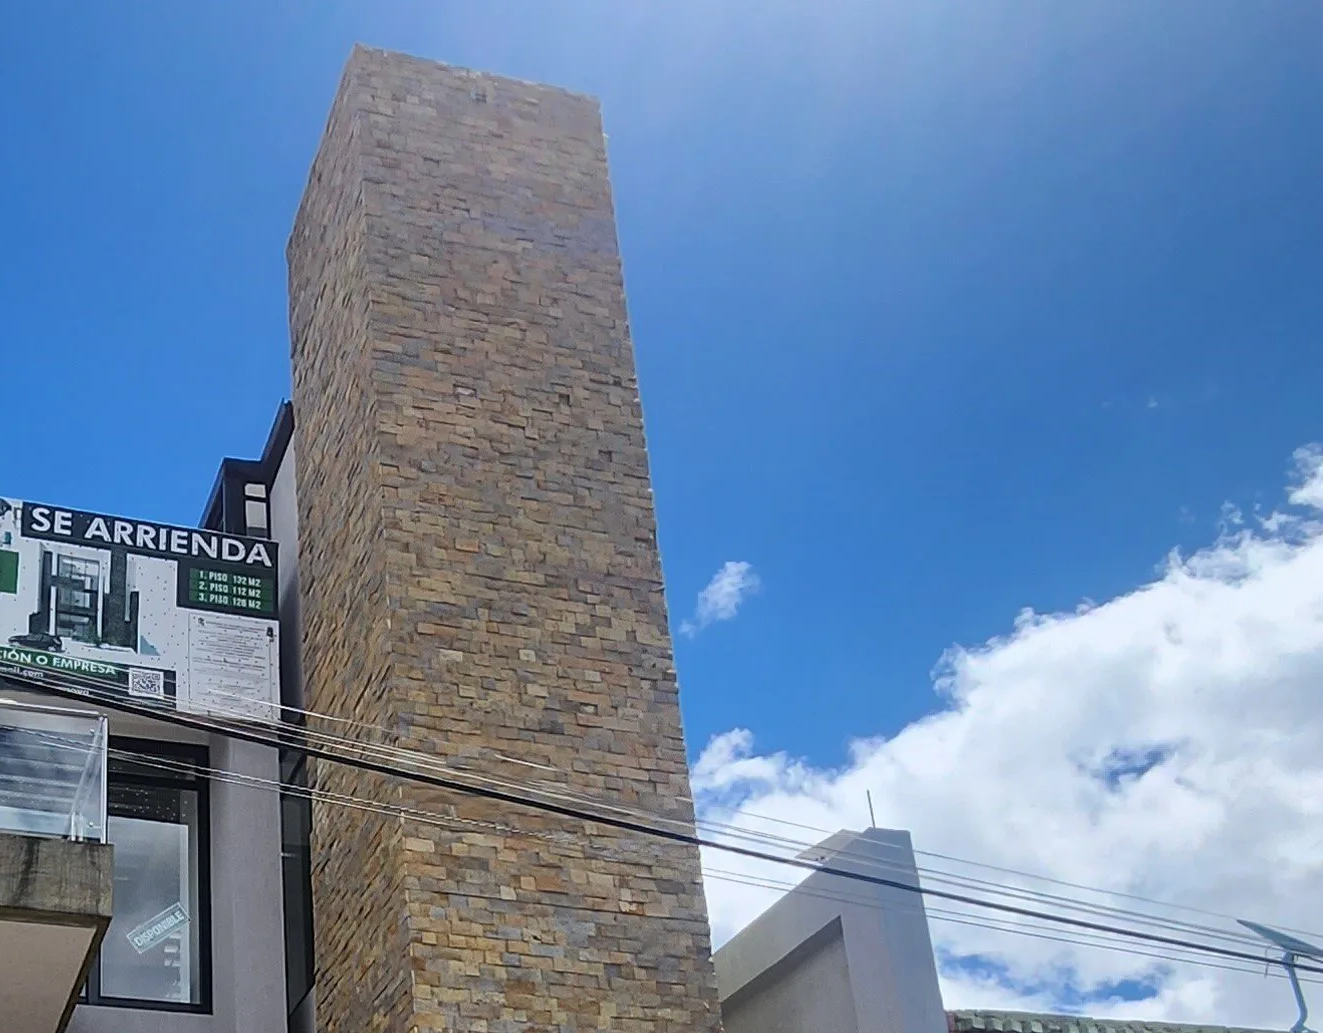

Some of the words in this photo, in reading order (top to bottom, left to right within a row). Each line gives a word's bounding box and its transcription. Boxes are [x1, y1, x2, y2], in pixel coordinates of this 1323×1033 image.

[31, 507, 73, 536] SE
[84, 517, 273, 567] ARRIENDA
[209, 571, 228, 582] PISO
[209, 583, 228, 593] PISO
[209, 594, 229, 605] PISO
[35, 655, 49, 665] O
[52, 657, 117, 676] EMPRESA
[133, 910, 185, 946] DISPONIBLE
